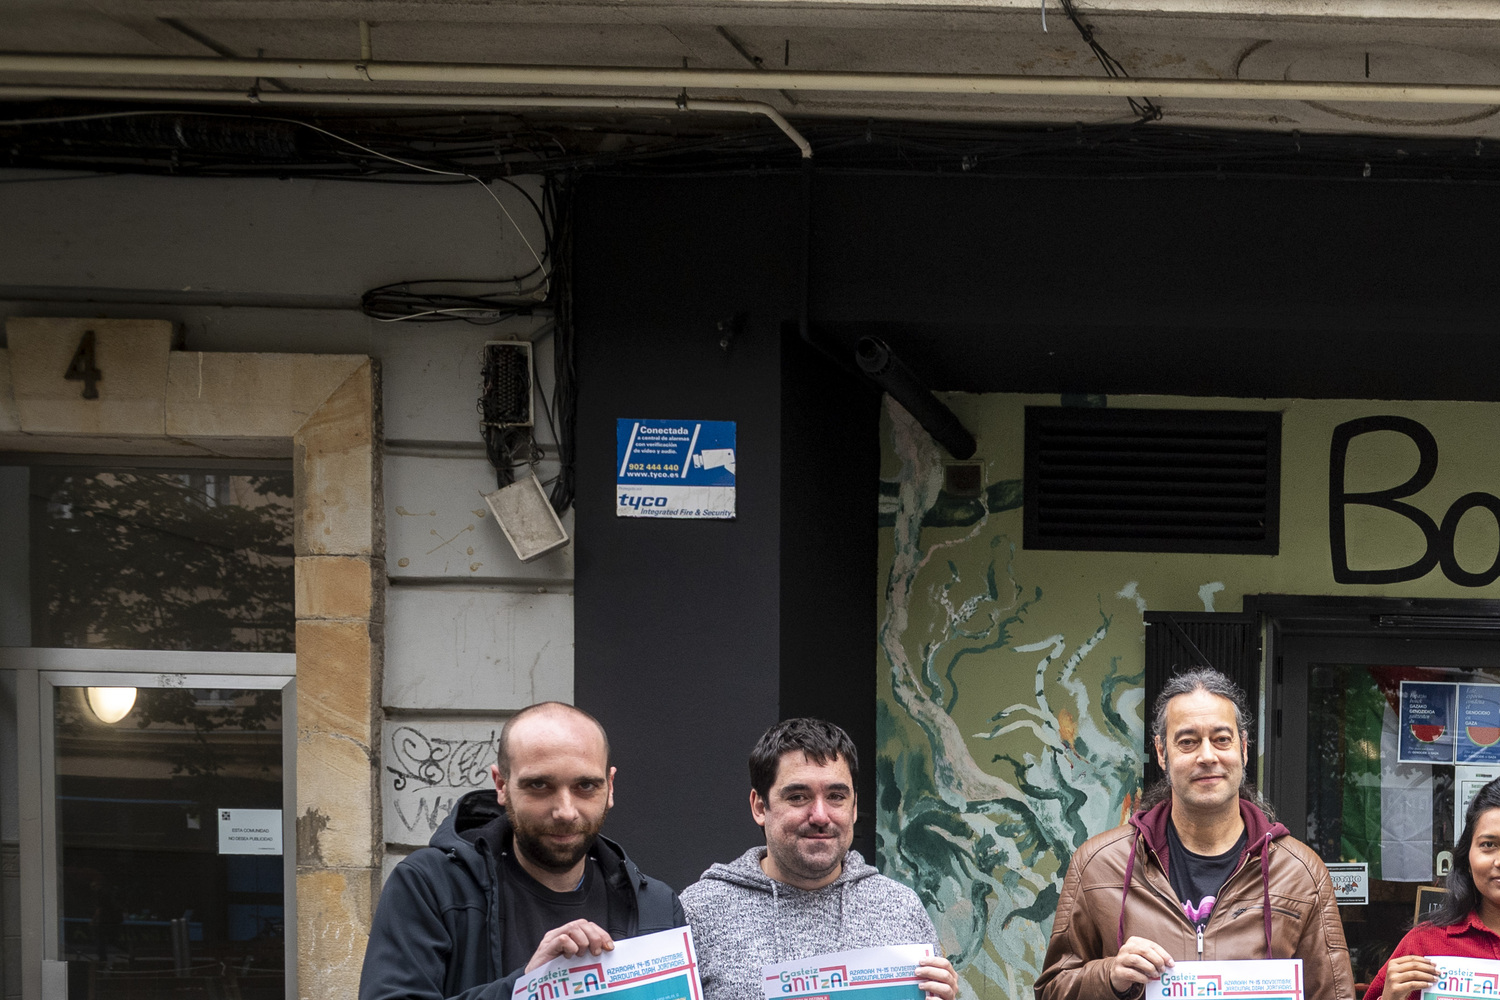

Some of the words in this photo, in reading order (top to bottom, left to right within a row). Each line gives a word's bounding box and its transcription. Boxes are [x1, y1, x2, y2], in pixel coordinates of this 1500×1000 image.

[64, 330, 102, 399] 4
[640, 426, 689, 435] Conectada
[628, 463, 644, 471] 902
[627, 471, 679, 479] www.tyco.es
[619, 493, 668, 510] tyco
[641, 508, 678, 516] Integrated
[702, 509, 732, 517] Security
[526, 967, 568, 991] Gasteiz
[779, 965, 818, 982] Gasteiz
[1161, 972, 1195, 986] Gasteiz
